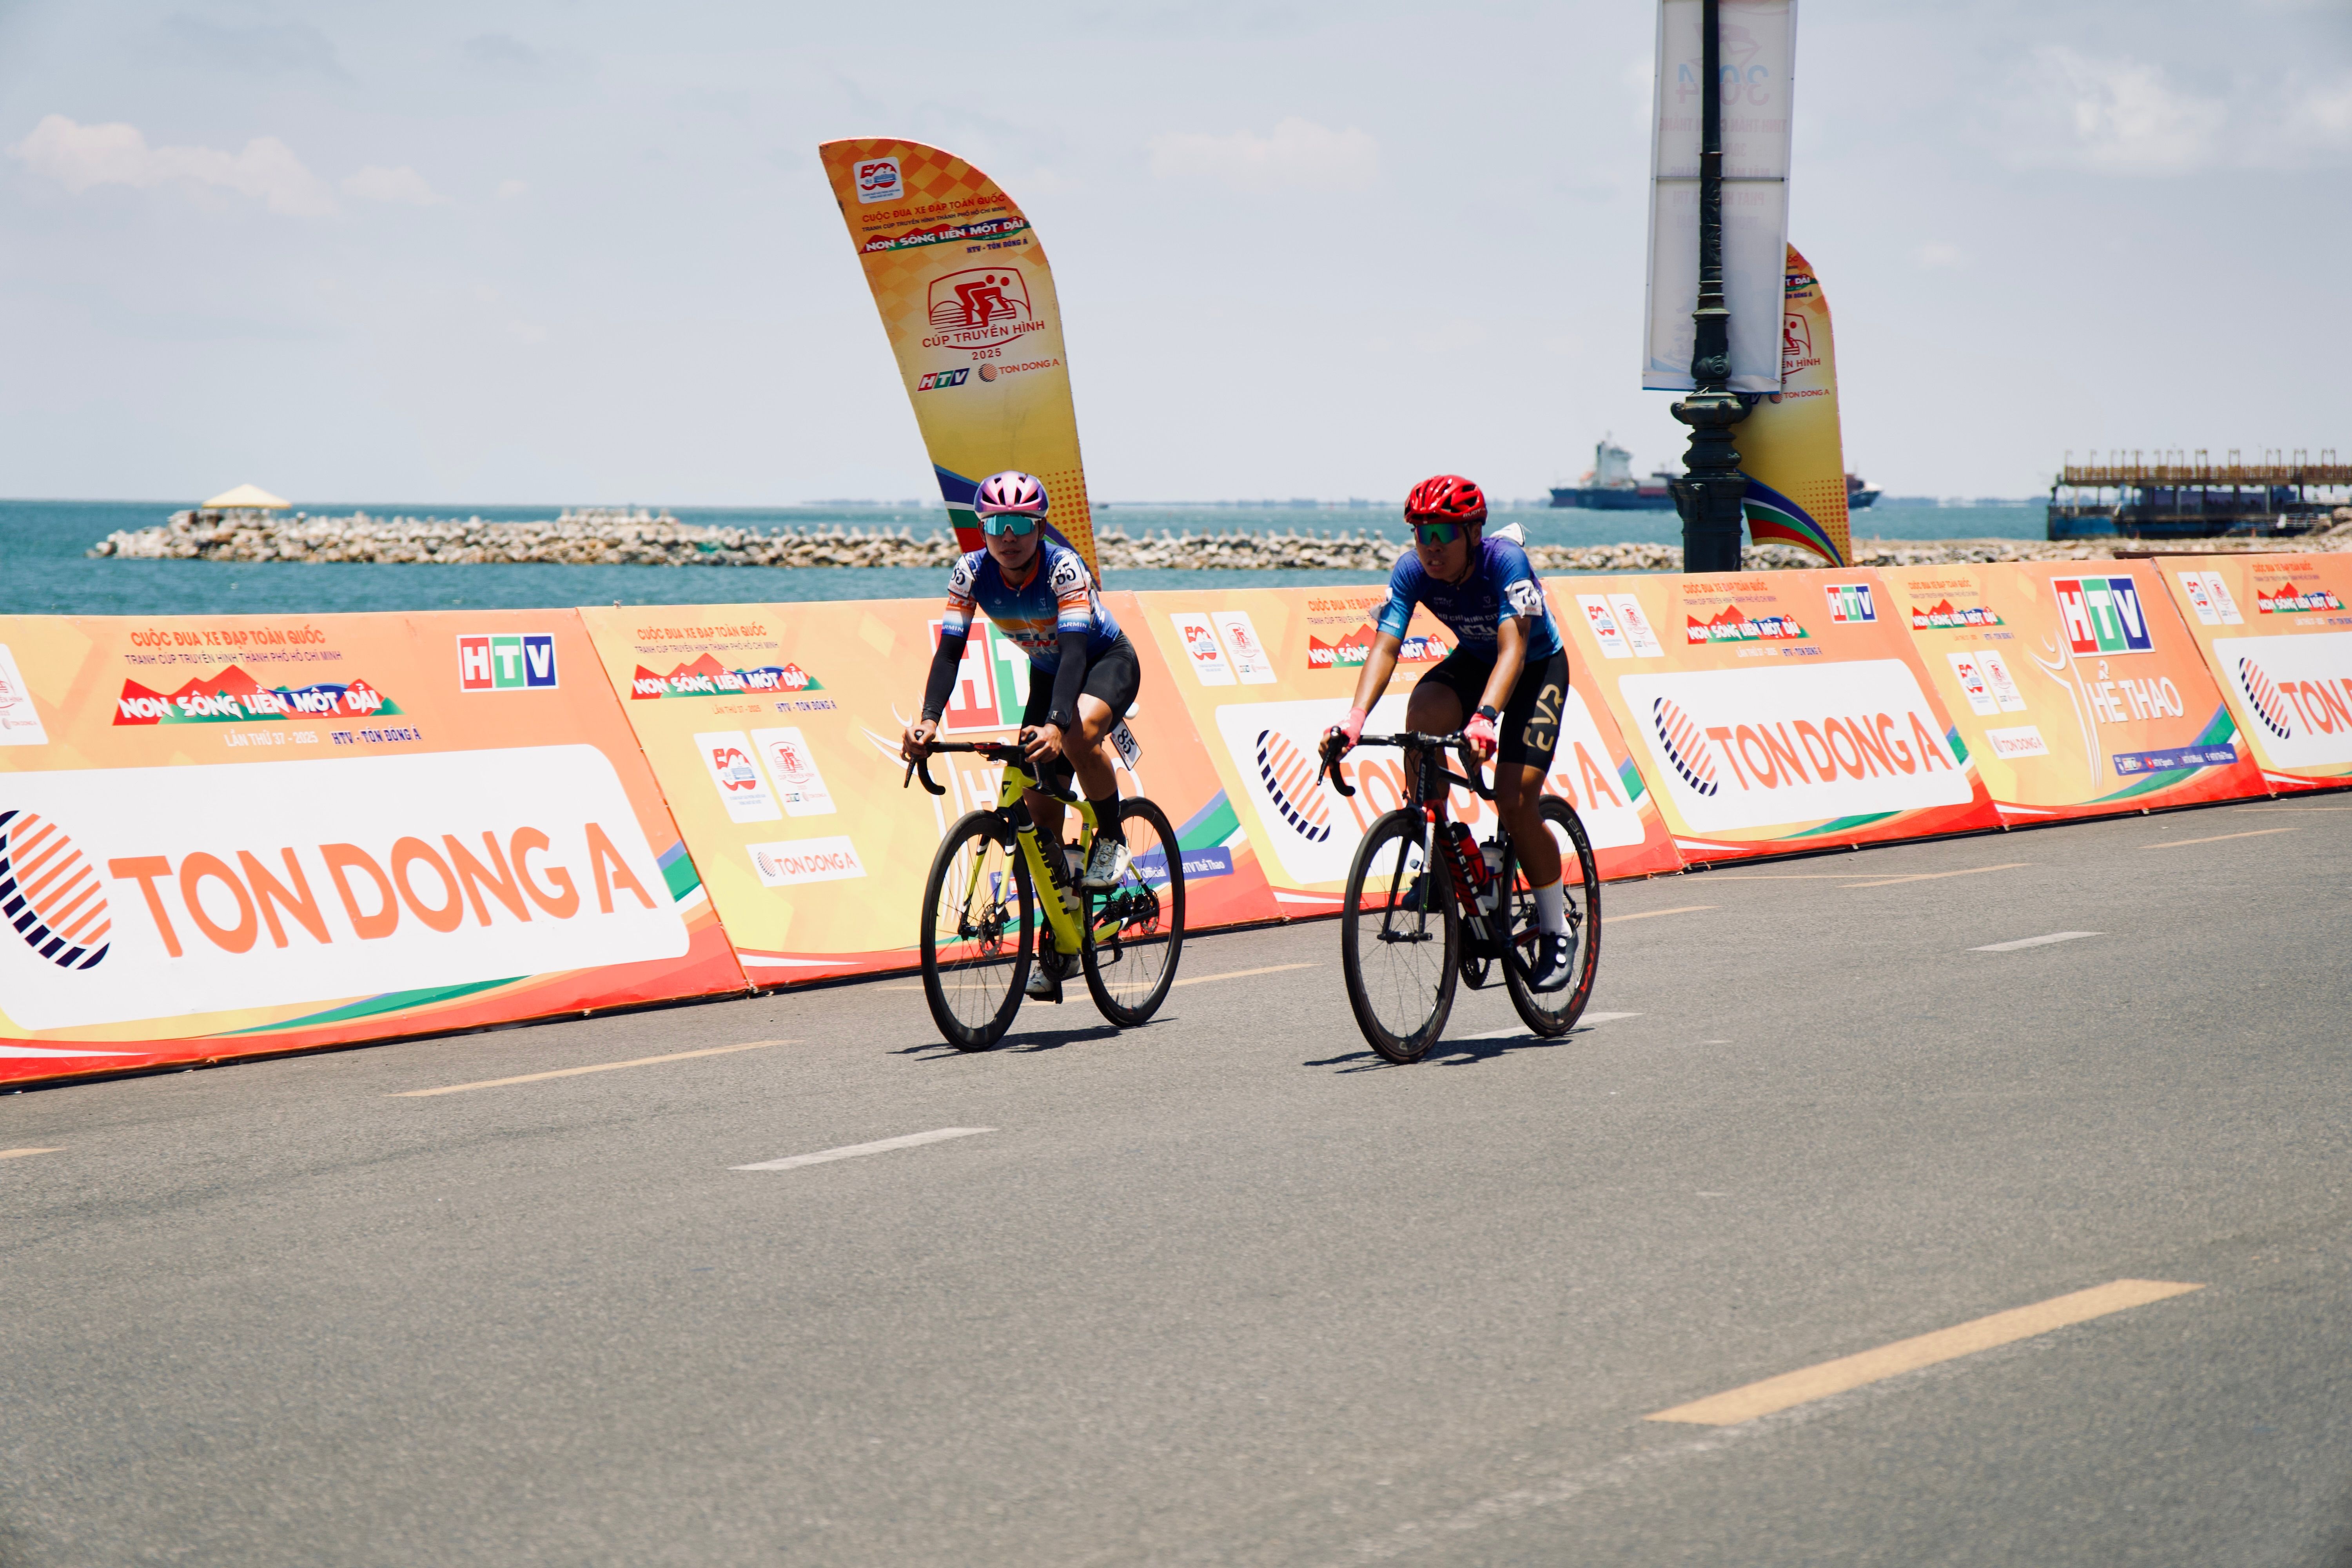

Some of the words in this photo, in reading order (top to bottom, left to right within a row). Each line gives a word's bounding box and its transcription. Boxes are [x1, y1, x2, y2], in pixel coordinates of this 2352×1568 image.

[862, 211, 890, 222] CUỘC
[914, 206, 926, 214] XE
[927, 203, 947, 213] ĐẠP
[949, 198, 975, 209] TOÀN
[977, 192, 1005, 205] QUỐC
[897, 218, 920, 227] TRUYỀN
[957, 209, 969, 218] PHỐ
[866, 240, 896, 251] NON
[899, 234, 936, 246] SÔNG
[939, 227, 966, 240] LIỀN
[969, 223, 998, 235] MỘT
[1003, 217, 1024, 230] DẢI
[986, 241, 1001, 250] TÔN
[1022, 236, 1028, 245] Á
[922, 334, 950, 348] CÚP
[953, 324, 1008, 343] TRUYỀN
[1013, 320, 1045, 334] HÌNH
[971, 348, 1002, 360] 2025
[1796, 357, 1821, 368] HÌNH
[918, 370, 969, 389] HTV
[998, 364, 1021, 374] TON
[1022, 360, 1051, 371] DONG
[1463, 508, 1481, 517] RUDY
[1308, 598, 1329, 614] CUỘC
[1330, 600, 1346, 611] ĐUA
[1345, 599, 1356, 609] XE
[1826, 589, 1873, 618] HTV
[2274, 595, 2299, 611] SÔNG
[1485, 612, 1500, 621] CIT
[1912, 615, 1931, 626] NON
[1929, 612, 1954, 627] SÔNG
[1949, 609, 1969, 624] LIỀN
[1965, 610, 1985, 626] MỘT
[1983, 608, 1998, 624] DẢI
[2055, 584, 2146, 647] HTV
[131, 628, 172, 650] CUỘC
[174, 631, 203, 646] ĐUA
[201, 631, 221, 645] XE
[219, 631, 248, 649] ĐẠP
[249, 627, 287, 645] TOÀN
[287, 624, 326, 644] QUỐC
[637, 626, 664, 642] CUỘC
[664, 628, 684, 639] ĐUA
[683, 627, 697, 639] XE
[695, 627, 714, 641] ĐẠP
[715, 624, 740, 637] TOÀN
[740, 621, 767, 637] QUỐC
[1687, 626, 1712, 640] NON
[1710, 621, 1743, 640] SÔNG
[1738, 617, 1762, 637] LIỀN
[1760, 619, 1784, 639] MỘT
[1782, 617, 1801, 637] DẢI
[124, 654, 158, 664] TRANH
[158, 652, 177, 664] CÚP
[178, 650, 216, 664] TRUYỀN
[216, 651, 239, 663] HÌNH
[238, 650, 270, 662] THÀNH
[270, 648, 289, 662] PHỐ
[289, 648, 303, 661] HỒ
[303, 649, 321, 661] CHÍ
[319, 651, 343, 660] MINH
[1307, 648, 1339, 664] NON
[1401, 639, 1428, 661] MỘT
[1426, 636, 1449, 659] DẢI
[460, 641, 553, 683] HTV
[632, 677, 671, 694] NON
[670, 672, 717, 694] SÔNG
[713, 668, 747, 690] LIỀN
[745, 669, 781, 691] MỘT
[781, 666, 809, 689] DẢI
[118, 697, 174, 718] NON
[176, 690, 244, 719] SÔNG
[241, 684, 290, 715] LIỀN
[290, 686, 341, 717] MỘT
[343, 683, 382, 713] DẢI
[774, 702, 791, 713] HTV
[795, 699, 811, 711] TÔN
[811, 698, 831, 711] ĐÔNG
[828, 696, 838, 709] Á
[2118, 677, 2184, 720] THAO
[2278, 680, 2352, 735] TON
[223, 729, 249, 747] LẦN
[247, 729, 272, 745] THỨ
[272, 732, 285, 744] 37
[292, 731, 319, 744] 2025
[330, 731, 354, 745] HTV
[359, 726, 384, 743] TÔN
[382, 725, 413, 742] ĐÔNG
[411, 724, 422, 740] Á
[1117, 729, 1134, 754] 85
[2001, 739, 2020, 752] TON
[2016, 737, 2039, 751] DONG
[2036, 736, 2044, 748] A
[1706, 722, 1811, 791] TON
[1793, 712, 1916, 783] DONG
[1907, 711, 1953, 772] A
[1573, 741, 1623, 810] A
[774, 857, 806, 876] TON
[804, 853, 845, 873] DONG
[844, 852, 857, 868] A
[1207, 860, 1225, 870] Thao
[1568, 818, 1595, 890] BORA
[107, 847, 334, 957] TON
[318, 826, 580, 941] DONG
[584, 822, 659, 915] A
